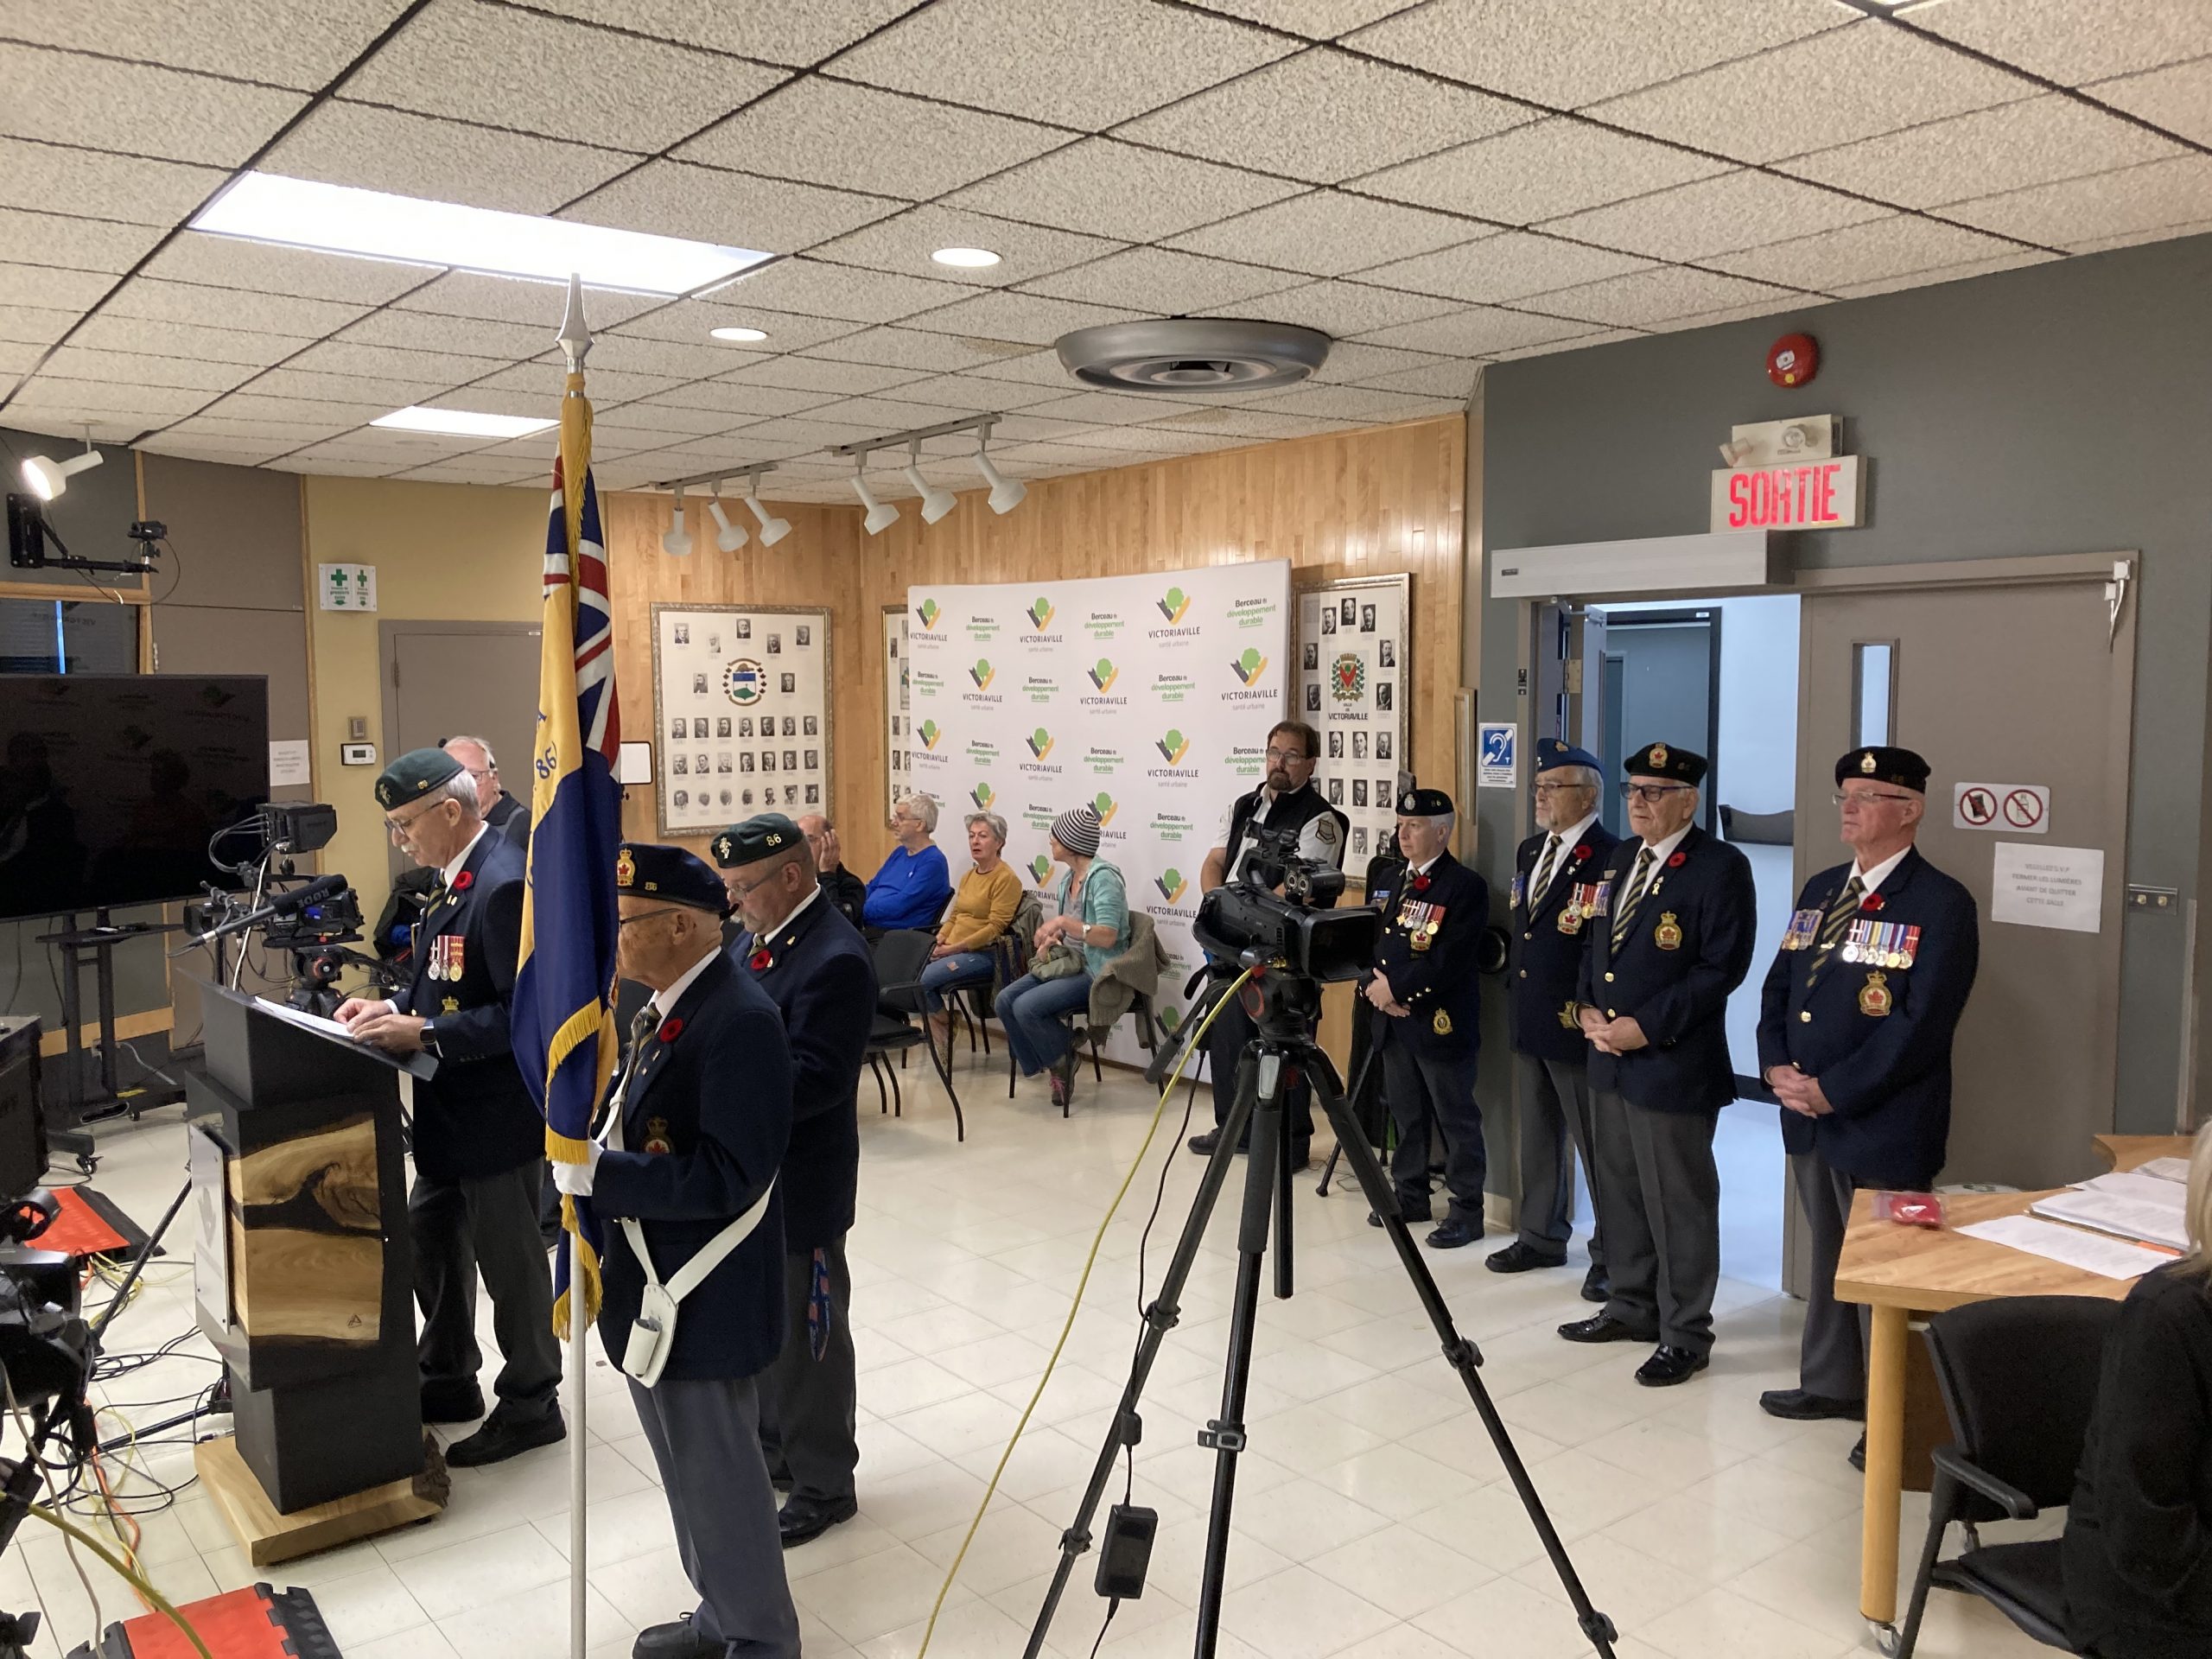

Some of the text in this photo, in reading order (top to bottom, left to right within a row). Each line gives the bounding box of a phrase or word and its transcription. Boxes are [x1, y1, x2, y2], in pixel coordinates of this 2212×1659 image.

[1729, 464, 1841, 527] SORTIE
[1236, 599, 1262, 608] Berceau
[1227, 603, 1275, 619] développement
[1084, 620, 1124, 629] développement
[1238, 616, 1263, 626] durable
[910, 632, 947, 642] VICTORIAVILLE
[1094, 629, 1114, 638] durable
[1148, 626, 1200, 639] VICTORIAVILLE
[1020, 635, 1062, 644] VICTORIAVILLE
[1152, 683, 1195, 692] développement
[963, 694, 1002, 703] VICTORIAVILLE
[1162, 691, 1184, 700] durable
[1222, 690, 1277, 701] VICTORIAVILLE
[912, 752, 948, 763] VICTORIAVILLE
[1224, 755, 1267, 766] développeme
[1020, 764, 1062, 774] VICTORIAVILLE
[1147, 769, 1198, 778] VICTORIAVILLE
[1029, 804, 1048, 812] Berceau
[1150, 821, 1193, 831] développement
[1099, 830, 1126, 839] RIAVILLE
[766, 834, 782, 847] 86
[645, 881, 657, 891] 86
[1146, 906, 1198, 919] VICTORIAVILLE
